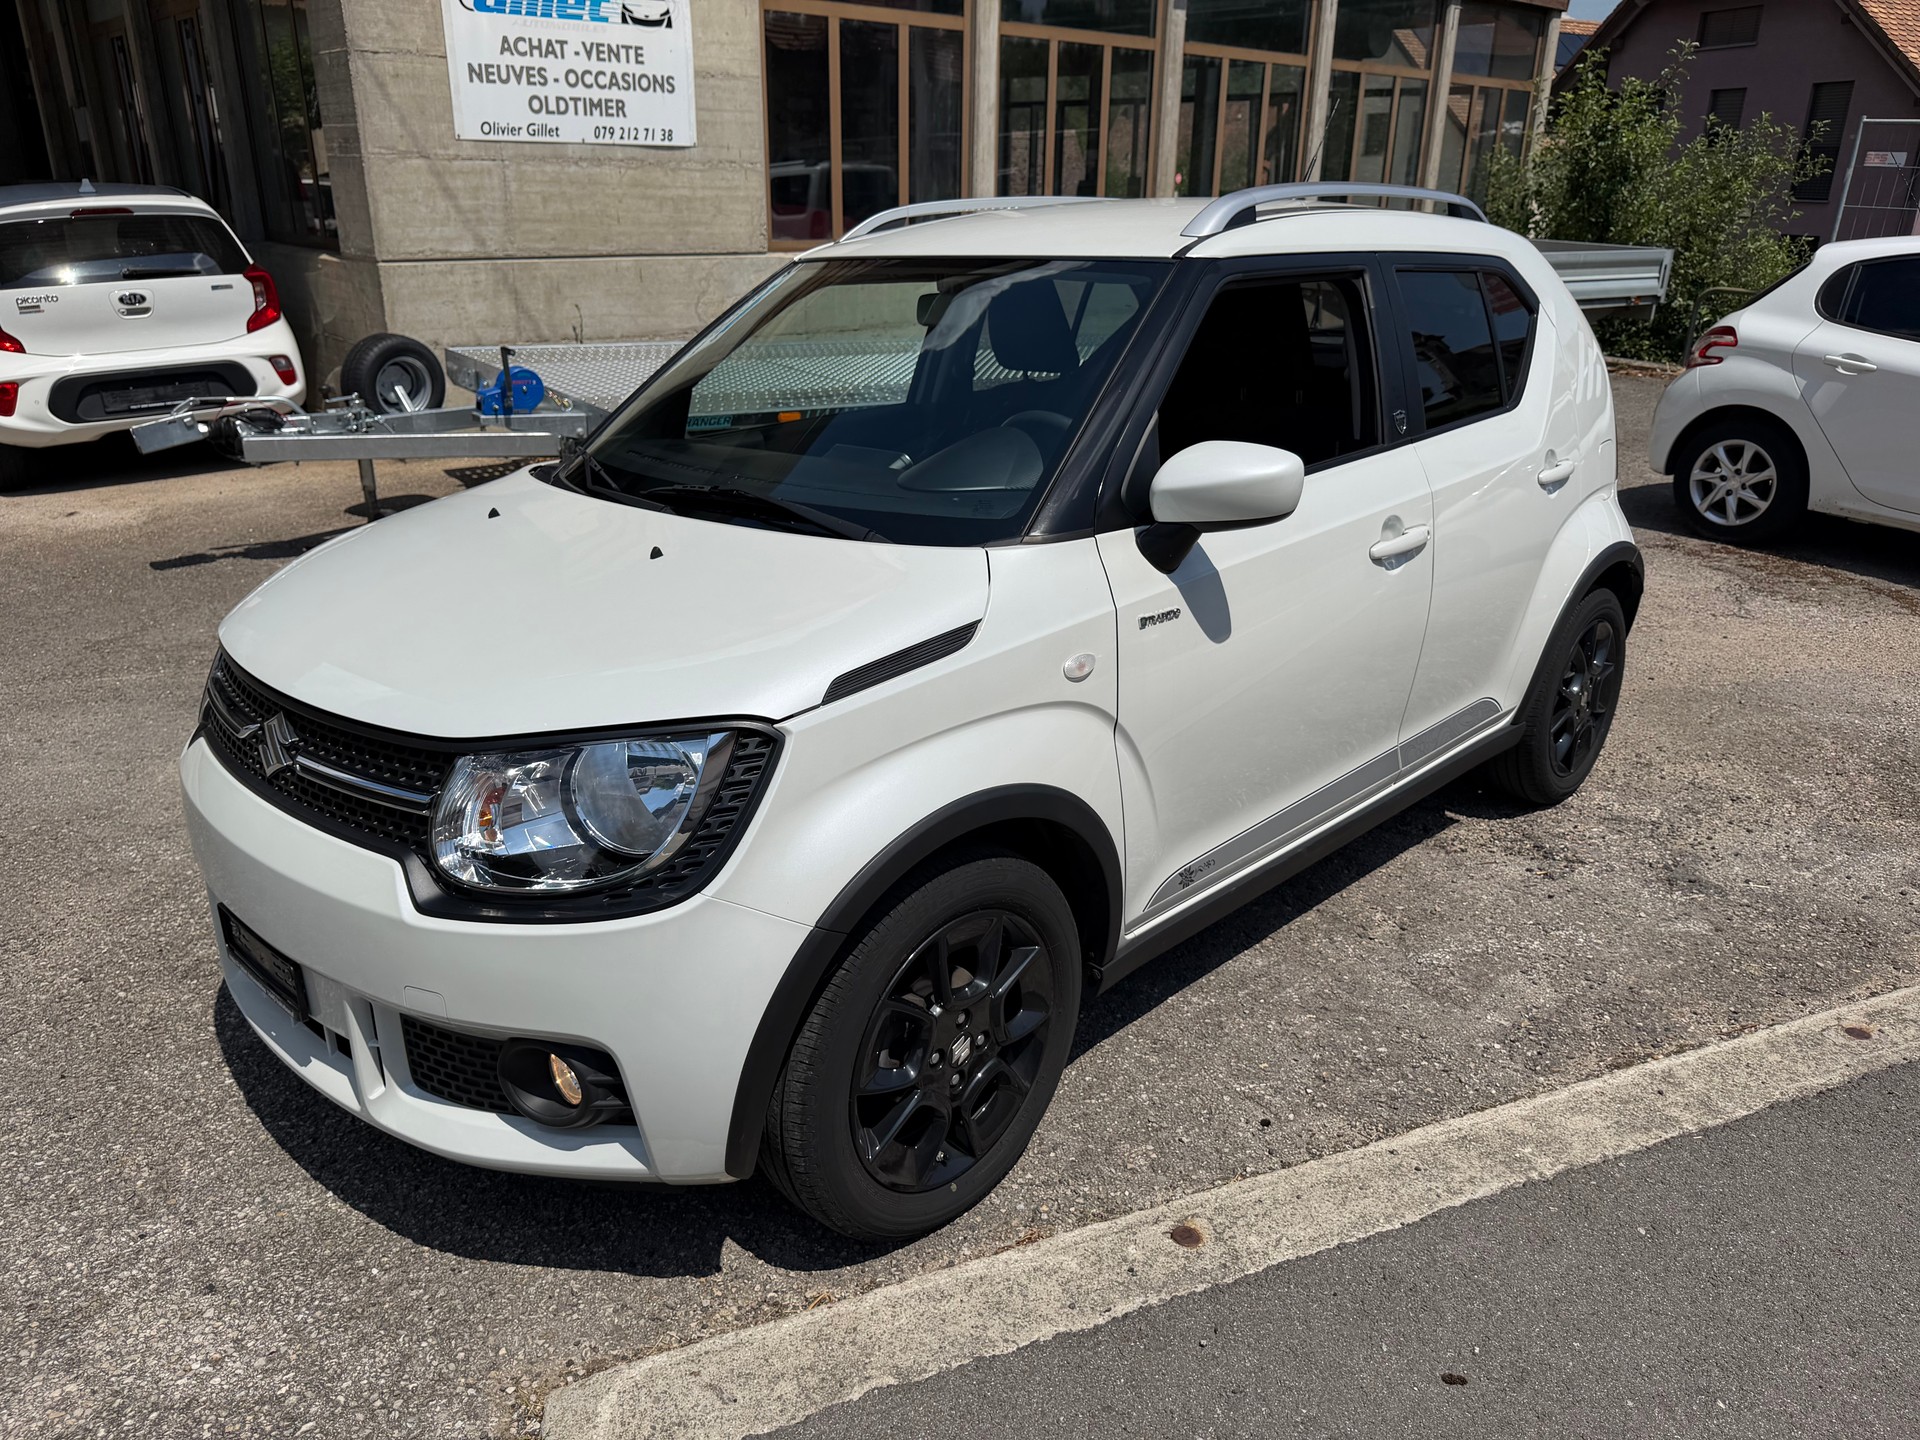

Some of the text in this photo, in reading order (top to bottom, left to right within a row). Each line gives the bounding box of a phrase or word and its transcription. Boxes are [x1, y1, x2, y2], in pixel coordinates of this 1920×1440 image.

[500, 36, 569, 60] ACHAT
[467, 63, 549, 87] NEUVES
[564, 69, 676, 94] OCCASIONS
[528, 95, 628, 119] OLDTIMER
[480, 121, 674, 143] Olivier Gillet 079 212 71 38
[15, 293, 59, 307] picanto
[121, 293, 144, 304] KIA
